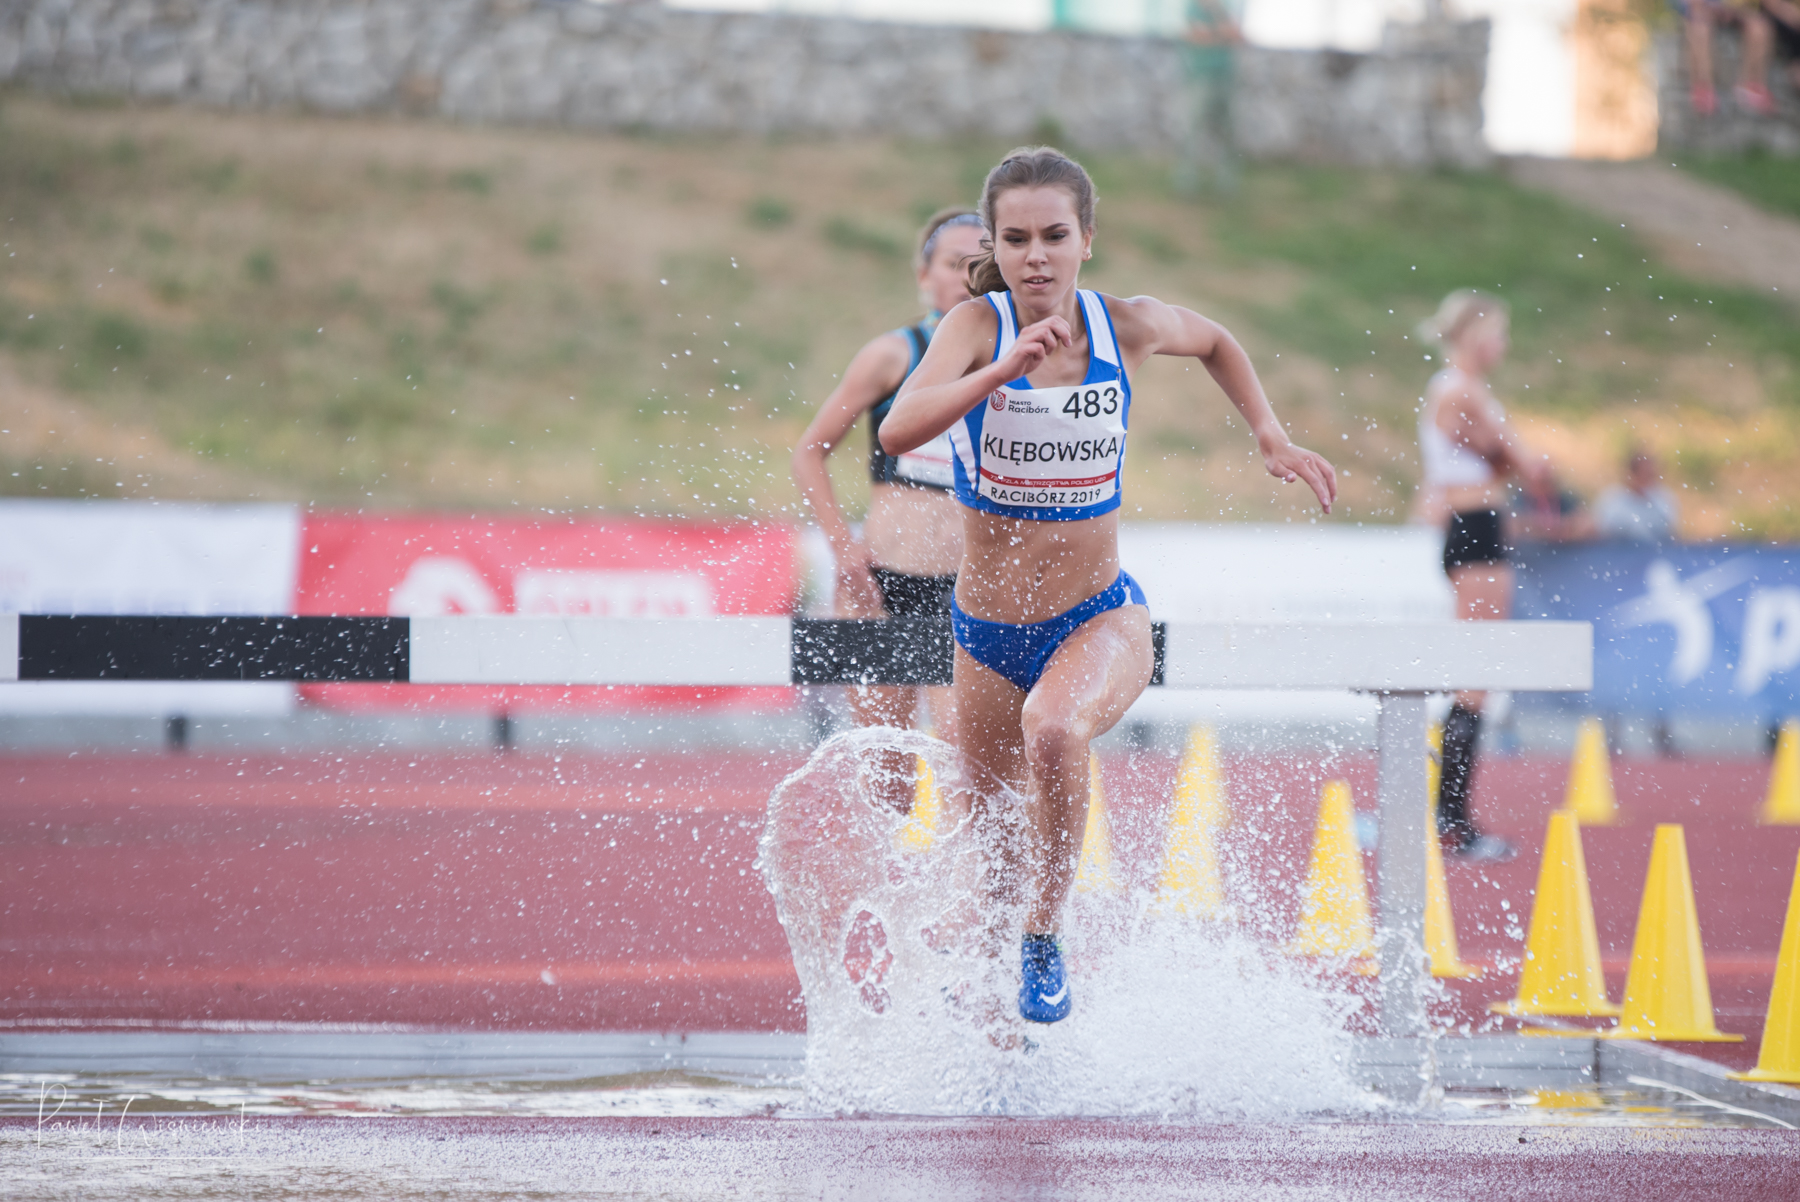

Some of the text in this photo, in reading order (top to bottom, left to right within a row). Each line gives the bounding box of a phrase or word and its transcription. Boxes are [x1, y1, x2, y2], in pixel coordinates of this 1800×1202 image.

[1008, 404, 1050, 414] Racibórz
[1062, 386, 1118, 419] 483
[984, 433, 1118, 466] KLĘBOWSKA
[990, 486, 1101, 504] RACIBÓRZ 2019
